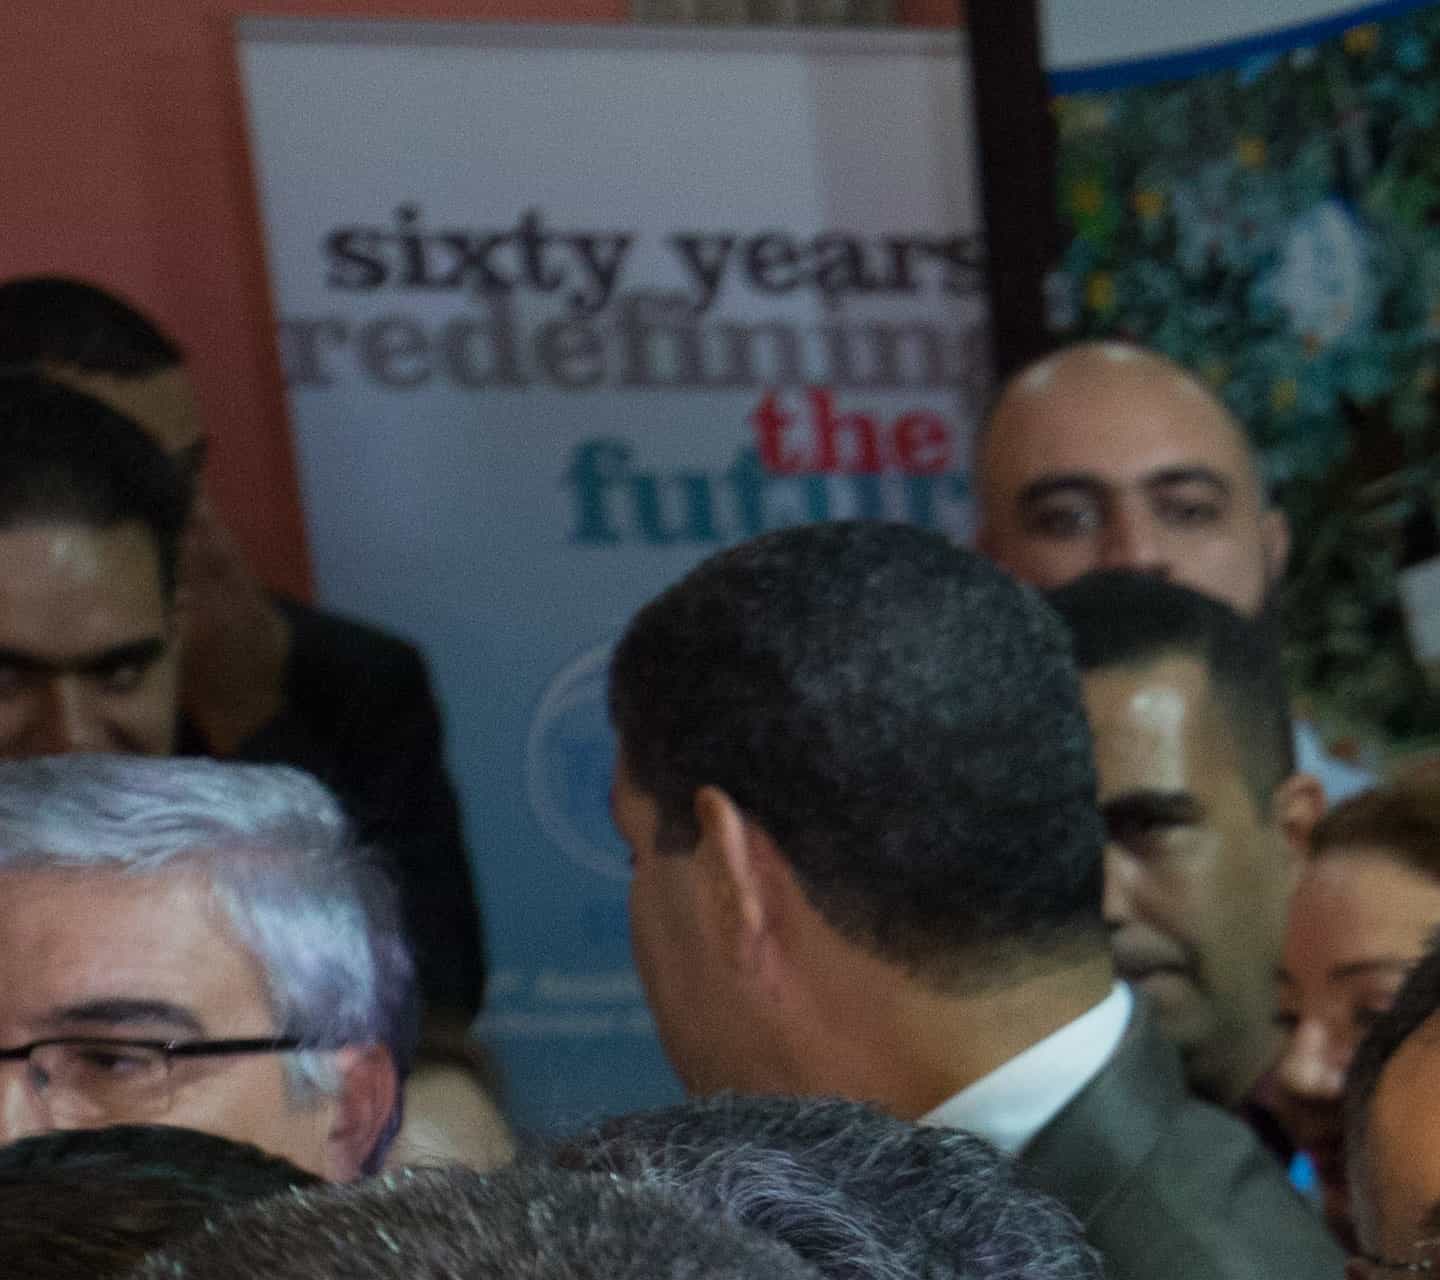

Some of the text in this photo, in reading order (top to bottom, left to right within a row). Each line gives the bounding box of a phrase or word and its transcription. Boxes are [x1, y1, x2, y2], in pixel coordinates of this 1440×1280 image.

[327, 204, 986, 312] sixty years
[752, 385, 952, 476] the
